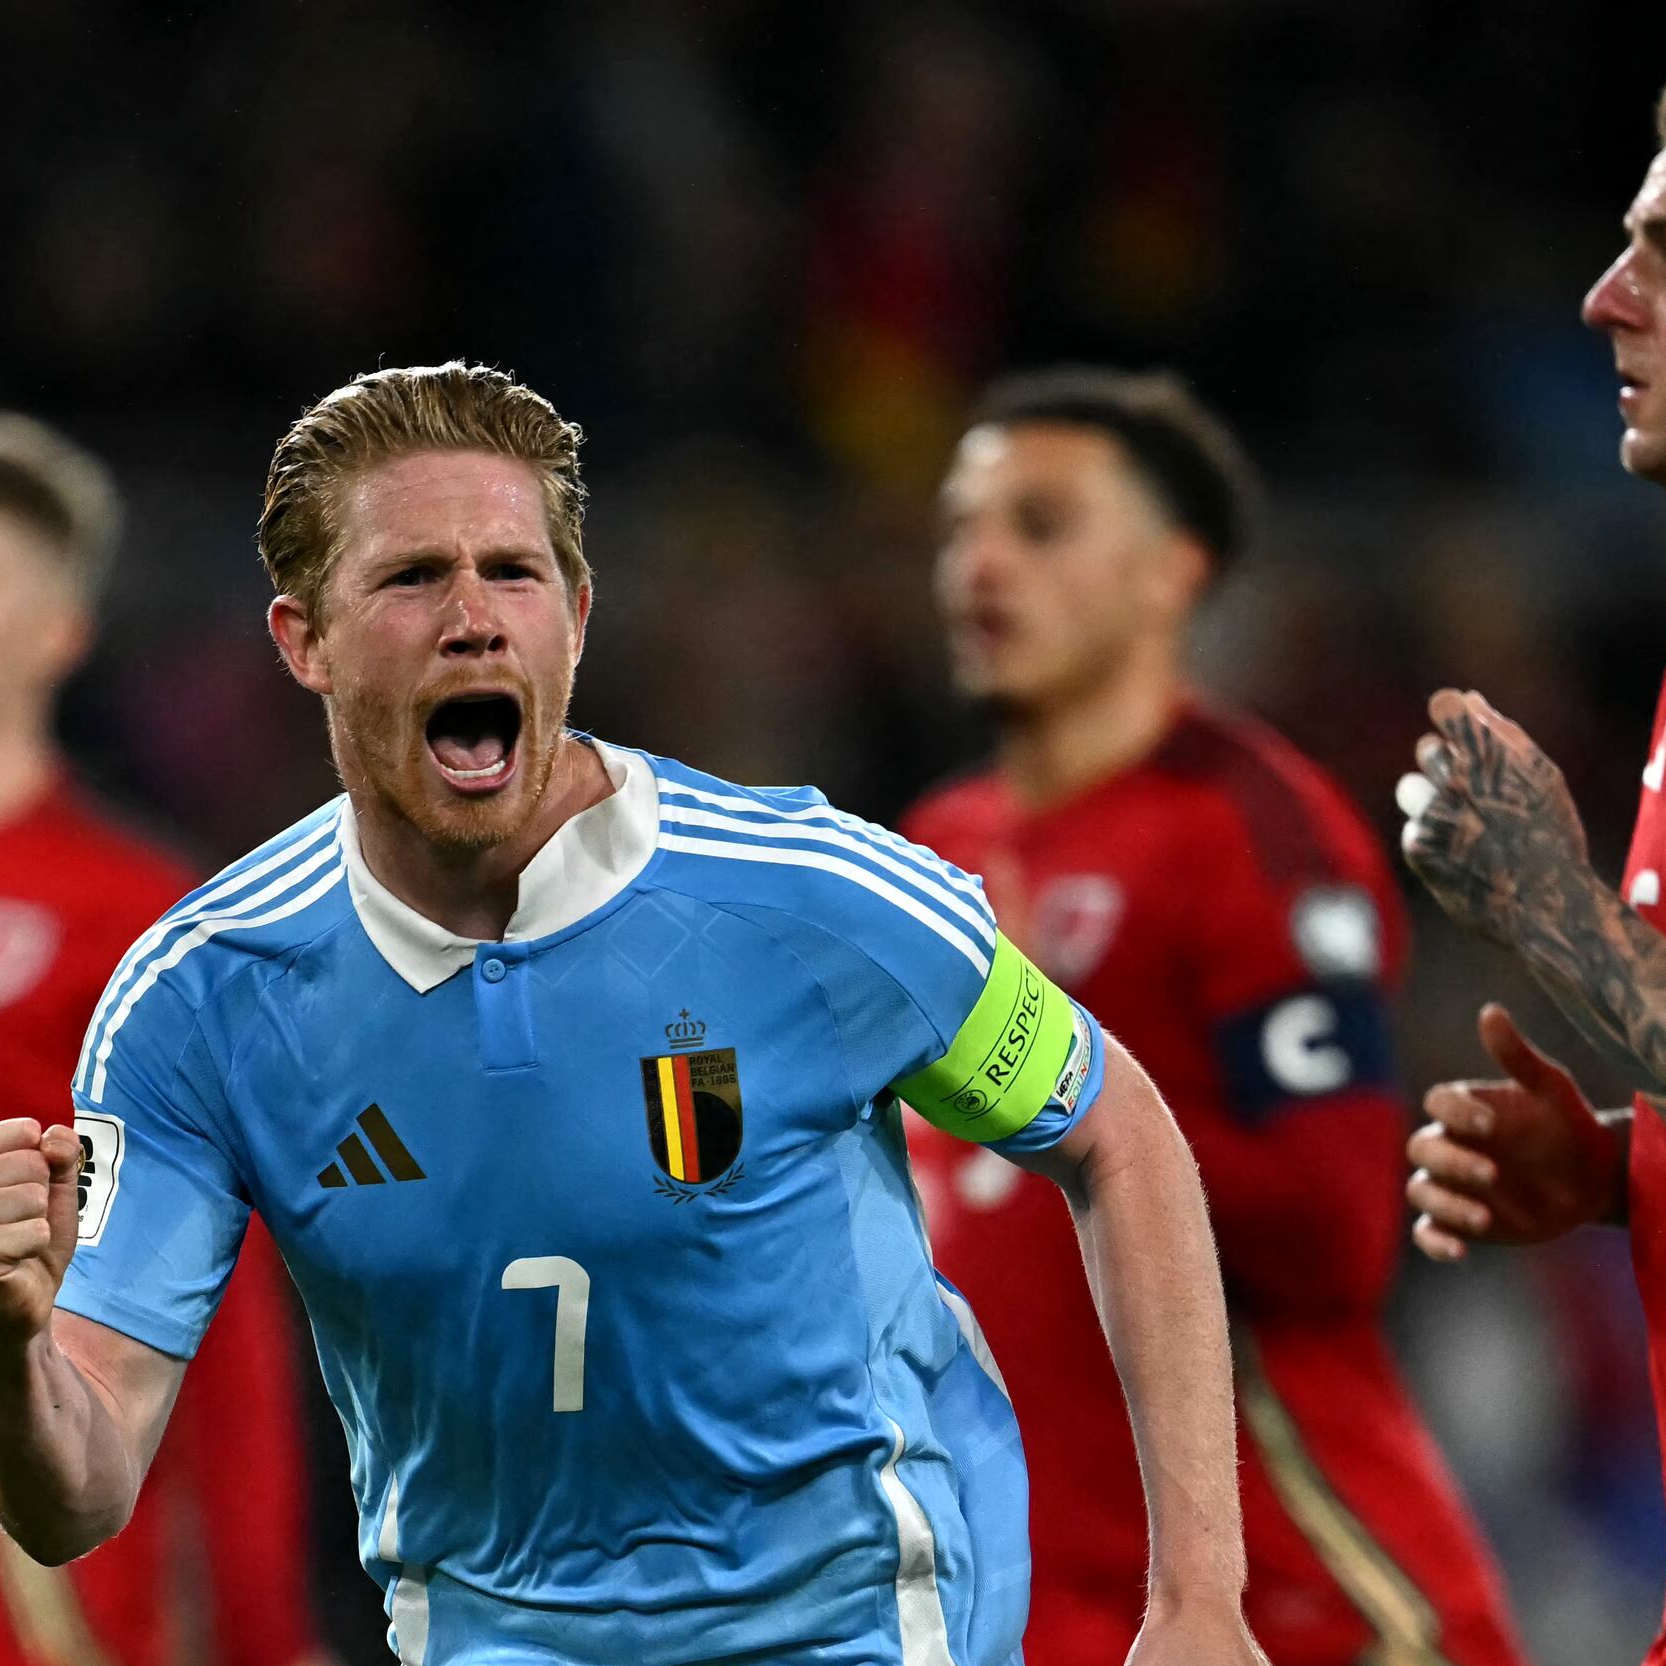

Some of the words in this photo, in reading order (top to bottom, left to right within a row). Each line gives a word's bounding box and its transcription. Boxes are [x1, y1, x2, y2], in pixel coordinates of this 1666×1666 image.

[985, 964, 1039, 1086] RESPECT
[1260, 995, 1351, 1094] C
[689, 1054, 721, 1065] ROYAL
[691, 1063, 735, 1076] BELGIAN
[692, 1078, 704, 1088] FA
[1056, 1071, 1074, 1098] UEFA
[502, 1255, 590, 1412] 7
